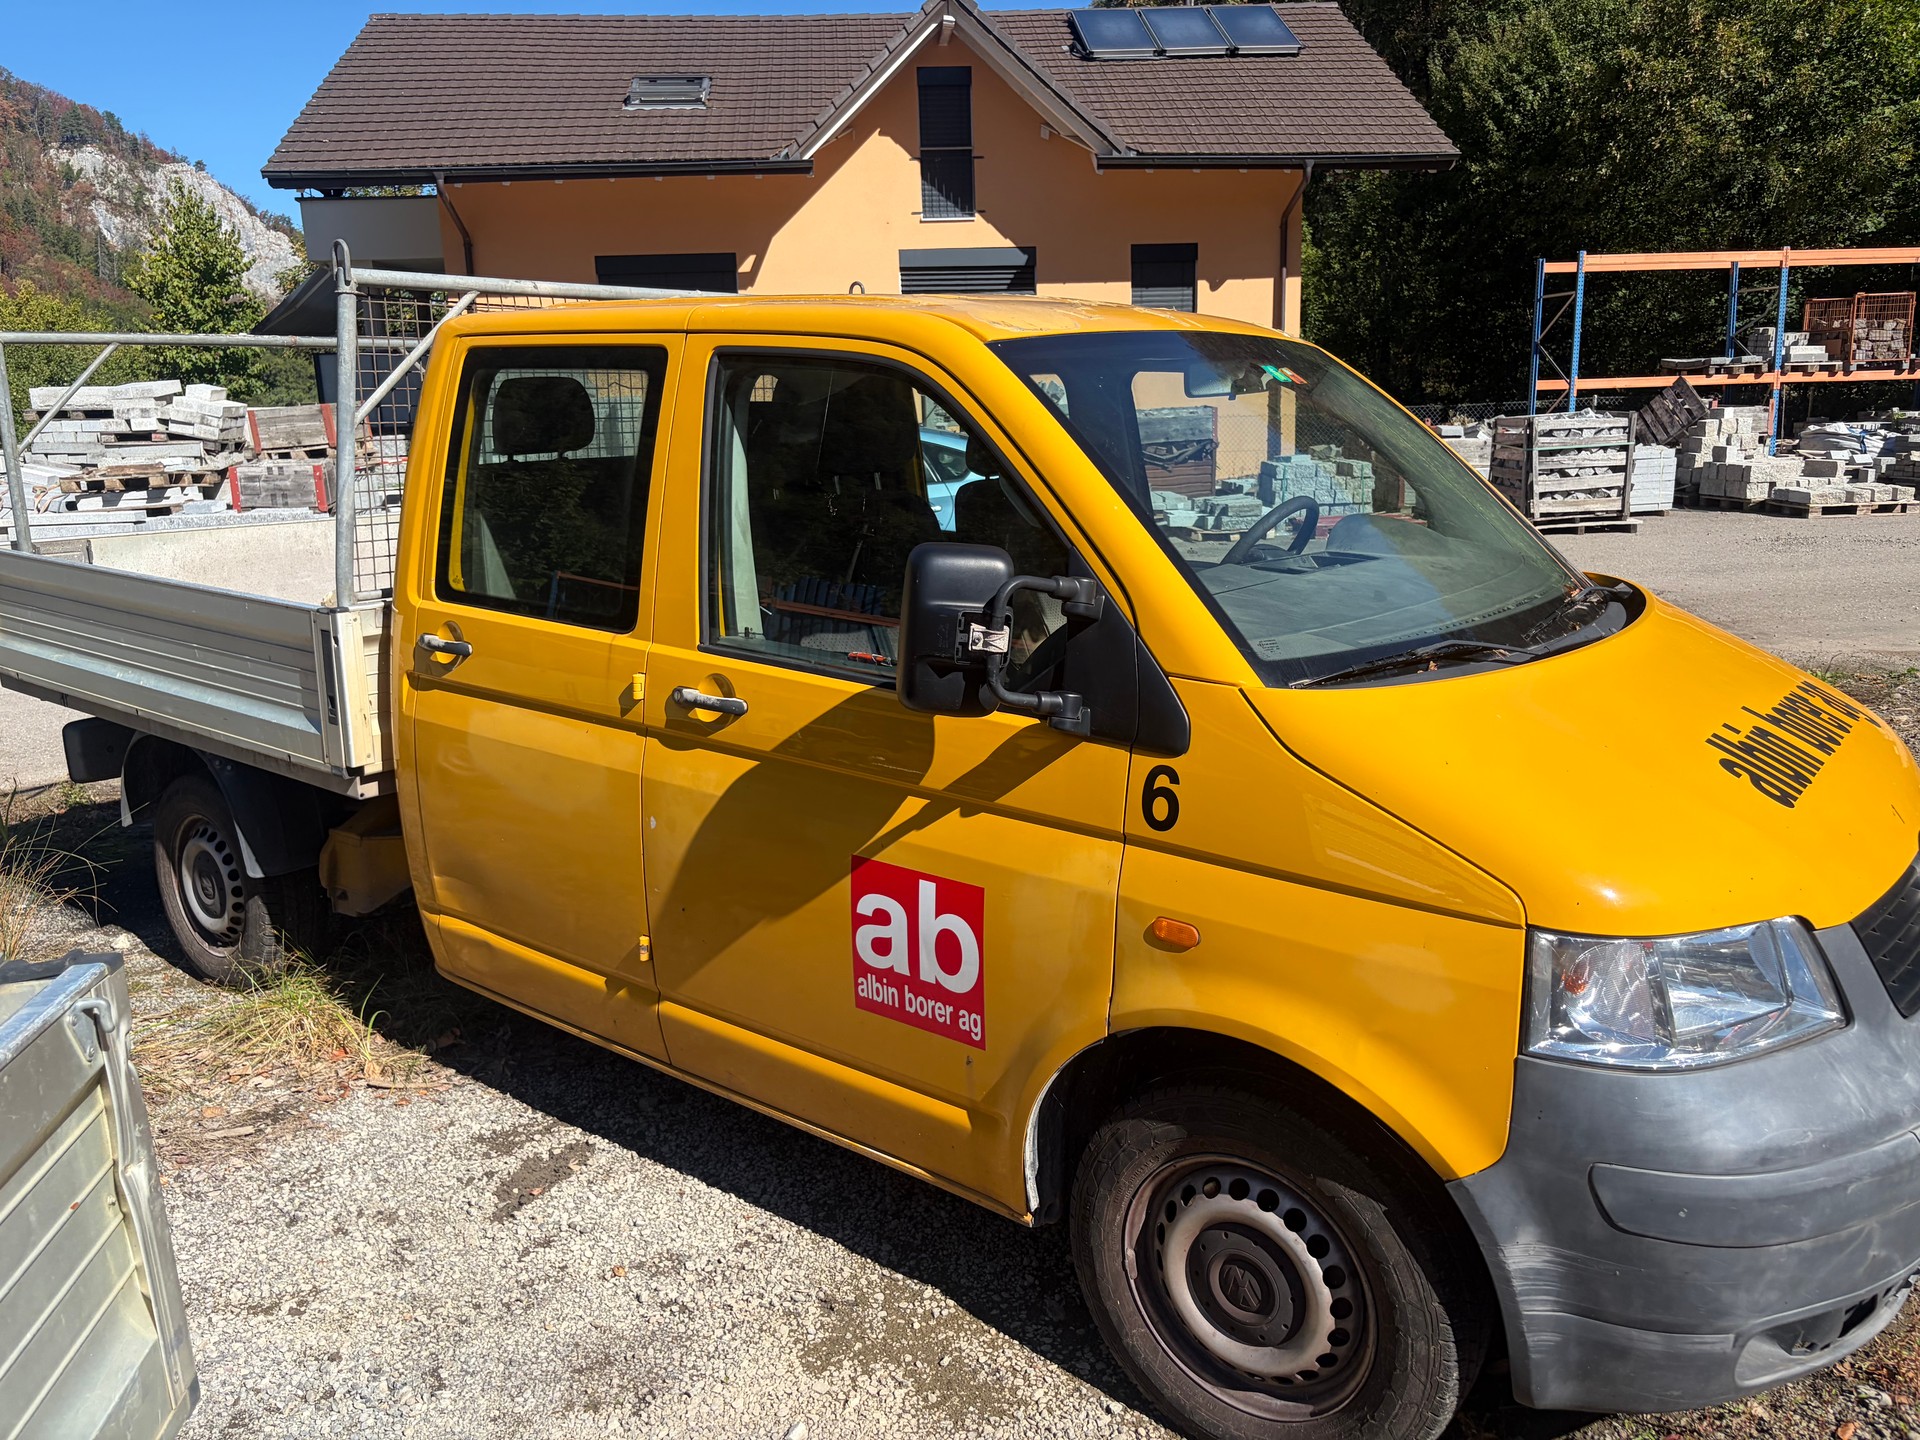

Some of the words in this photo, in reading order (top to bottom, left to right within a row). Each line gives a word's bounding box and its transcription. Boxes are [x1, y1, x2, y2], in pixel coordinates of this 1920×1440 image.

[1740, 690, 1853, 757] borer
[1796, 680, 1882, 729] ag
[1141, 763, 1181, 832] 6
[1705, 723, 1825, 808] albin
[854, 878, 980, 994] ab
[857, 973, 899, 1008] albin
[904, 984, 954, 1025] borer
[958, 1008, 982, 1041] ag
